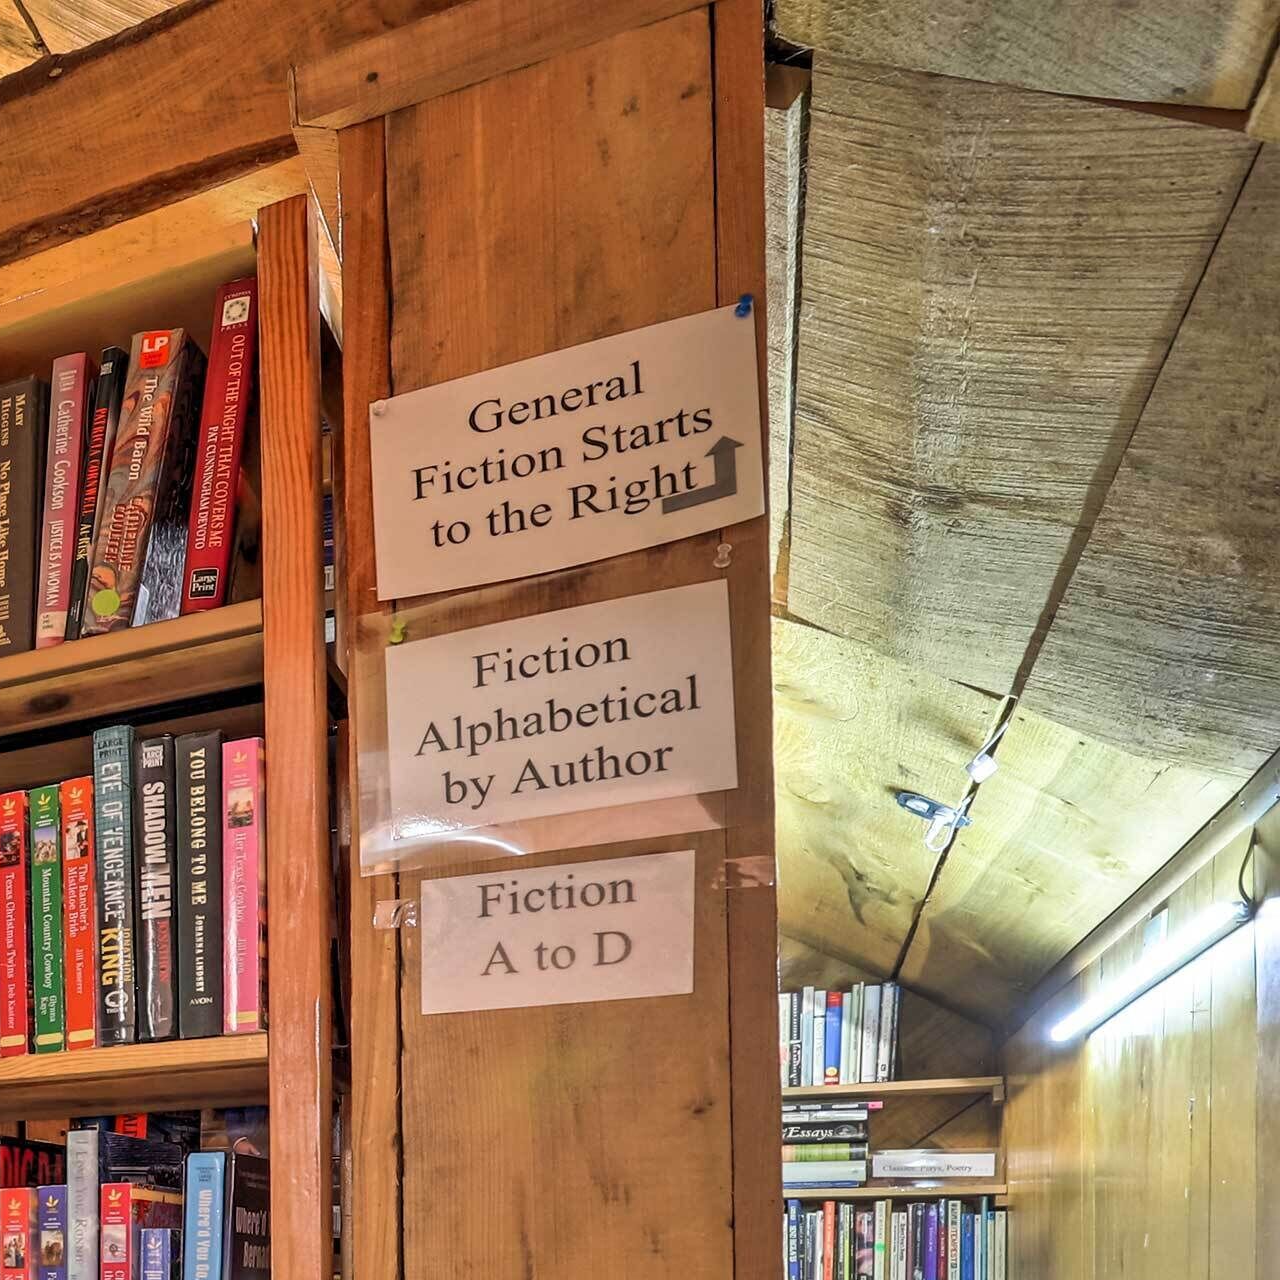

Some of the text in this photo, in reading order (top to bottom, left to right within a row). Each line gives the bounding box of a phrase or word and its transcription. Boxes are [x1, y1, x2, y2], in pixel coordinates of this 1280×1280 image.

[128, 375, 159, 481] The Wild Baron
[467, 361, 646, 436] General
[0, 460, 11, 480] No
[209, 334, 246, 548] OUT OF THE NIGHT THAT COVERS ME
[411, 406, 714, 500] Fiction Starts
[0, 483, 11, 517] Place
[0, 518, 10, 543] Like
[431, 460, 699, 549] to the Right
[472, 634, 631, 689] Fiction
[415, 676, 702, 759] Alphabetical
[443, 743, 675, 811] by Author
[141, 782, 171, 918] SHADOW MEN
[190, 748, 206, 905] YOU BELONG TO ME
[477, 875, 636, 920] Fiction
[481, 930, 632, 976] A to D
[788, 1127, 833, 1140] Essays
[946, 1164, 973, 1173] Poetry
